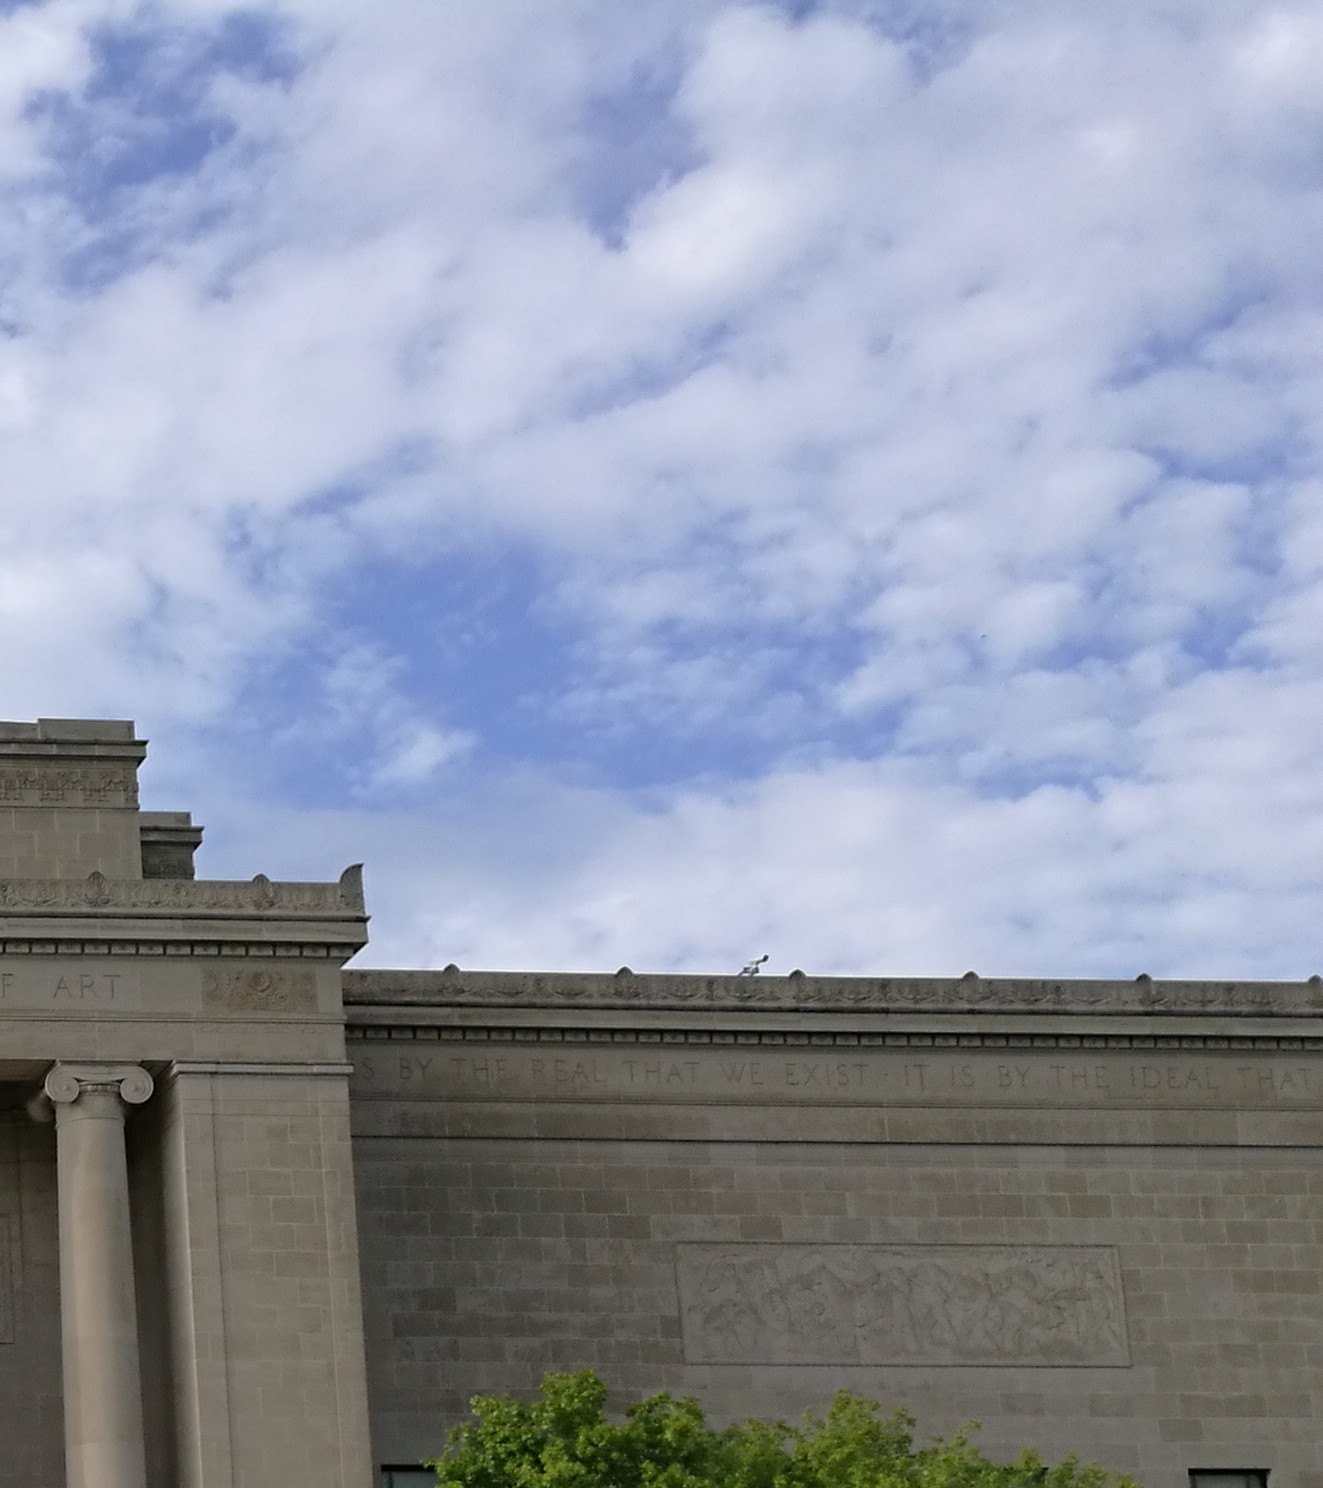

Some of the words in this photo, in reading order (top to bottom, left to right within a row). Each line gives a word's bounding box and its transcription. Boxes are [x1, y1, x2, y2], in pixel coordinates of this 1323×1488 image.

[51, 973, 122, 1000] ART
[398, 1056, 434, 1081] BY
[449, 1057, 515, 1082] THE
[531, 1058, 609, 1083] REAL
[622, 1059, 702, 1084] THAT
[718, 1061, 764, 1086] WE
[784, 1062, 870, 1087] EXIST
[904, 1063, 931, 1088] IT
[950, 1064, 977, 1088] IS
[997, 1065, 1030, 1089] BY
[1048, 1065, 1110, 1090] THE
[1129, 1066, 1221, 1091] IDEAL
[1236, 1067, 1313, 1091] THAT
